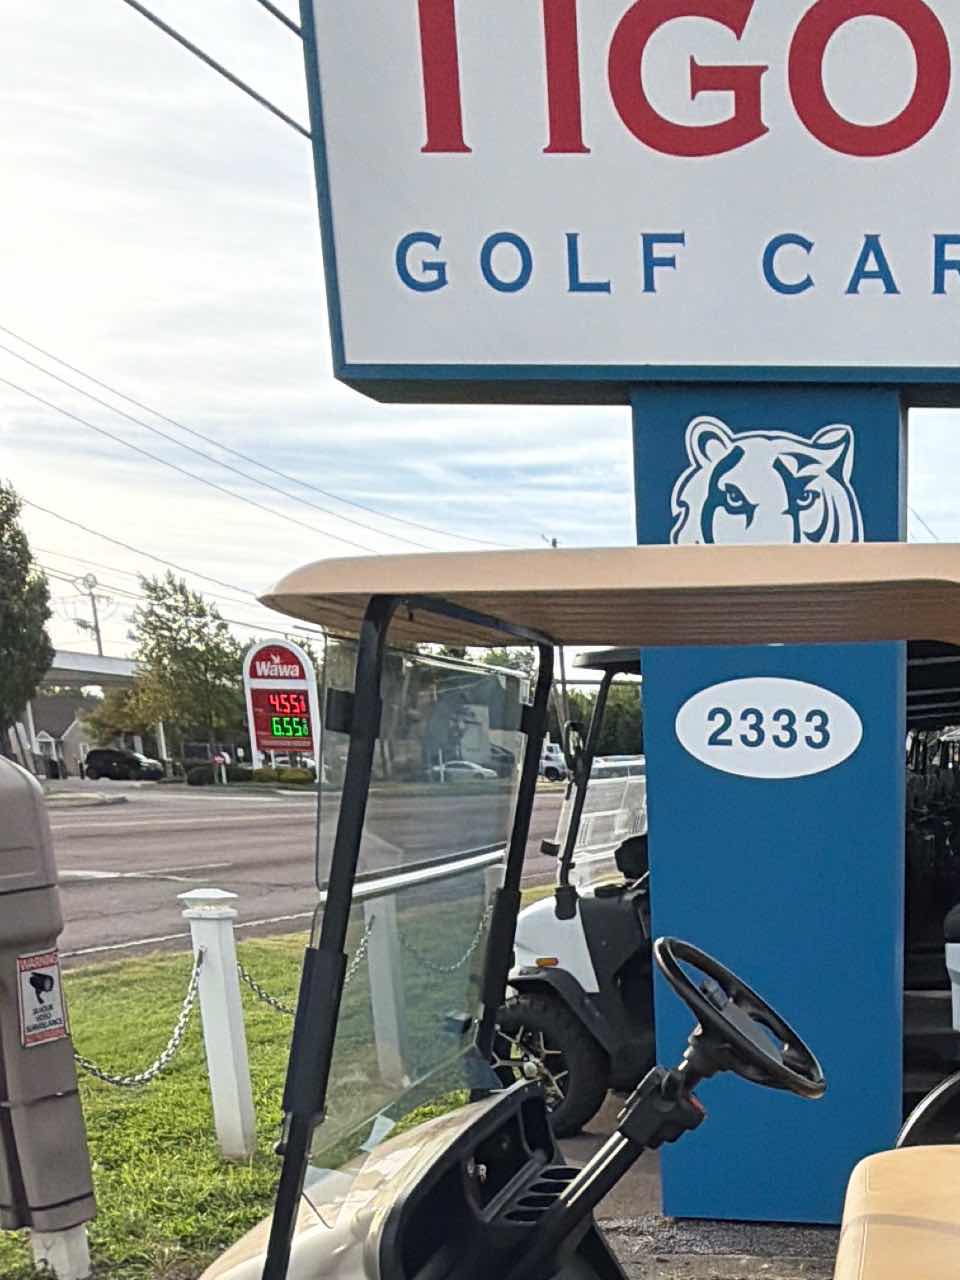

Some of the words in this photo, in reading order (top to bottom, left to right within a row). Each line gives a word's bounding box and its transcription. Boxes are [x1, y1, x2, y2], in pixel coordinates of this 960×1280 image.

[395, 231, 685, 294] GOLF
[256, 661, 300, 677] Wawa
[707, 707, 830, 749] 2333
